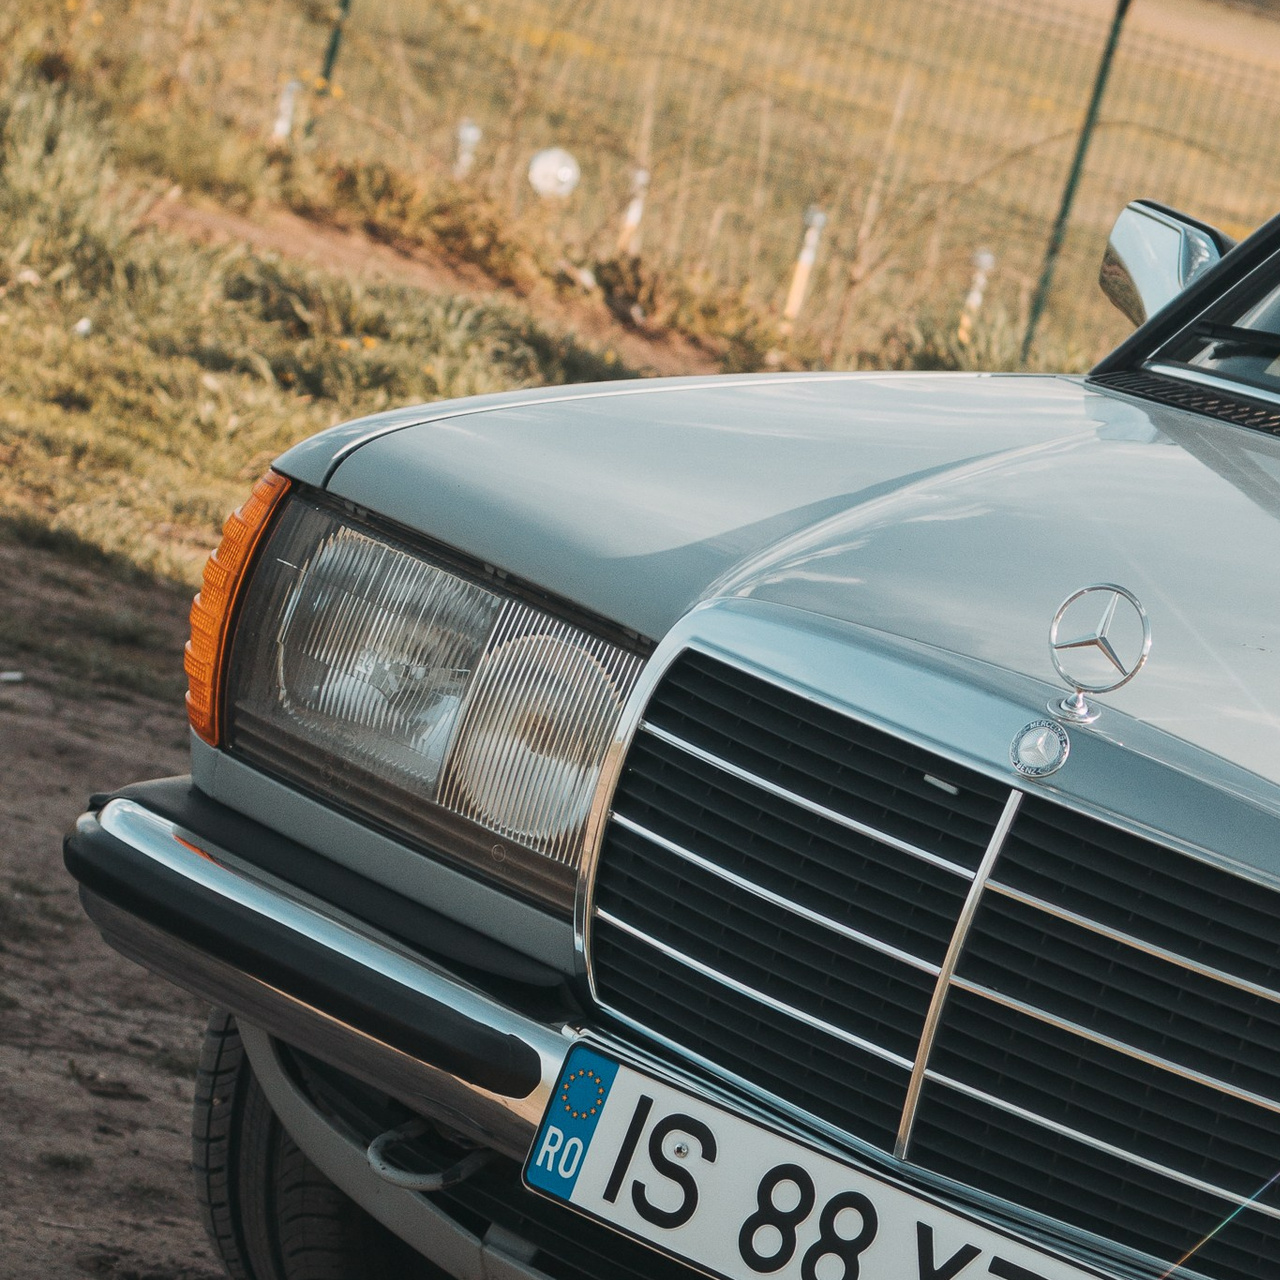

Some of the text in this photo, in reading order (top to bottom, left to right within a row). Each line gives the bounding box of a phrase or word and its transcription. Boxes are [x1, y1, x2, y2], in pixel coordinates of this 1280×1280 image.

[1030, 720, 1065, 741] MERCEDES
[1017, 763, 1037, 775] BENZ
[536, 1125, 584, 1179] RO
[603, 1095, 717, 1229] IS
